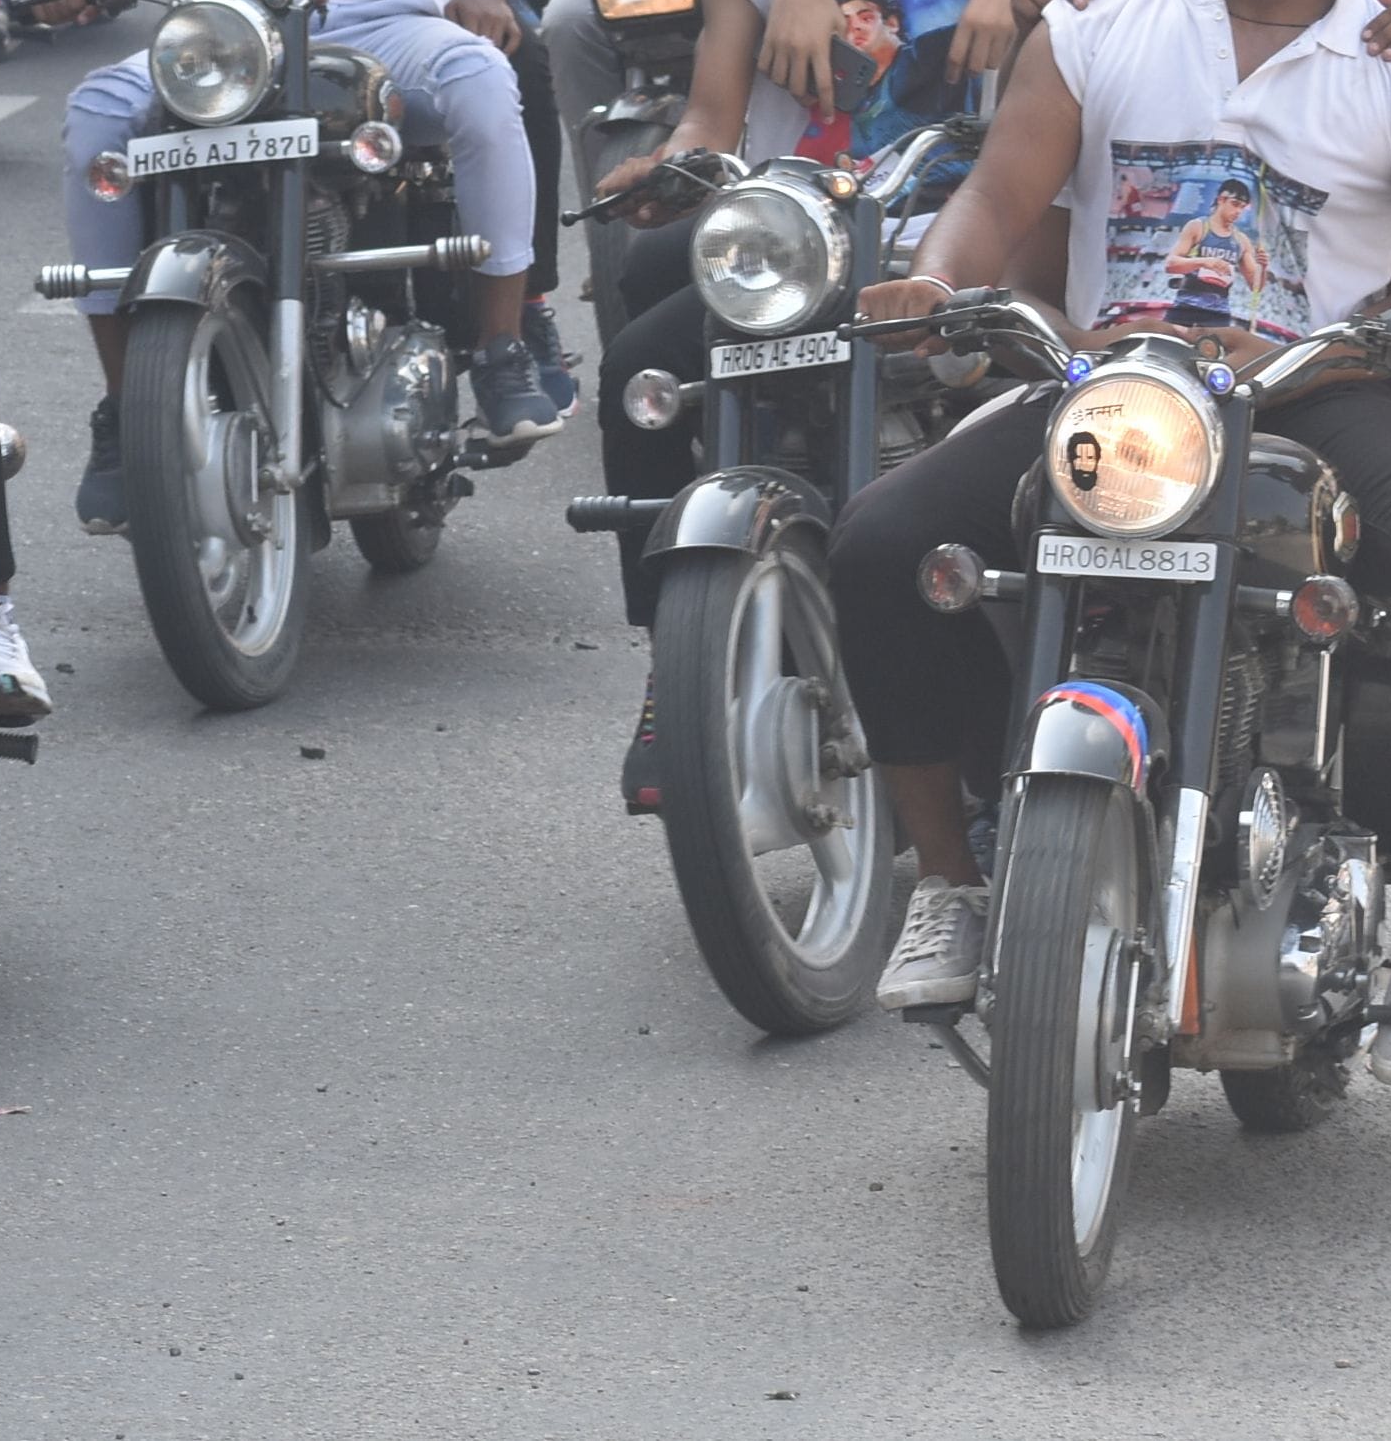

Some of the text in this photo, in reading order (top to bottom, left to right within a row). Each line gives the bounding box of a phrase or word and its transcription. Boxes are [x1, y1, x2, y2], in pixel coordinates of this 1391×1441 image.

[133, 134, 312, 173] HR06 AJ 7870
[1201, 245, 1238, 261] INDIA
